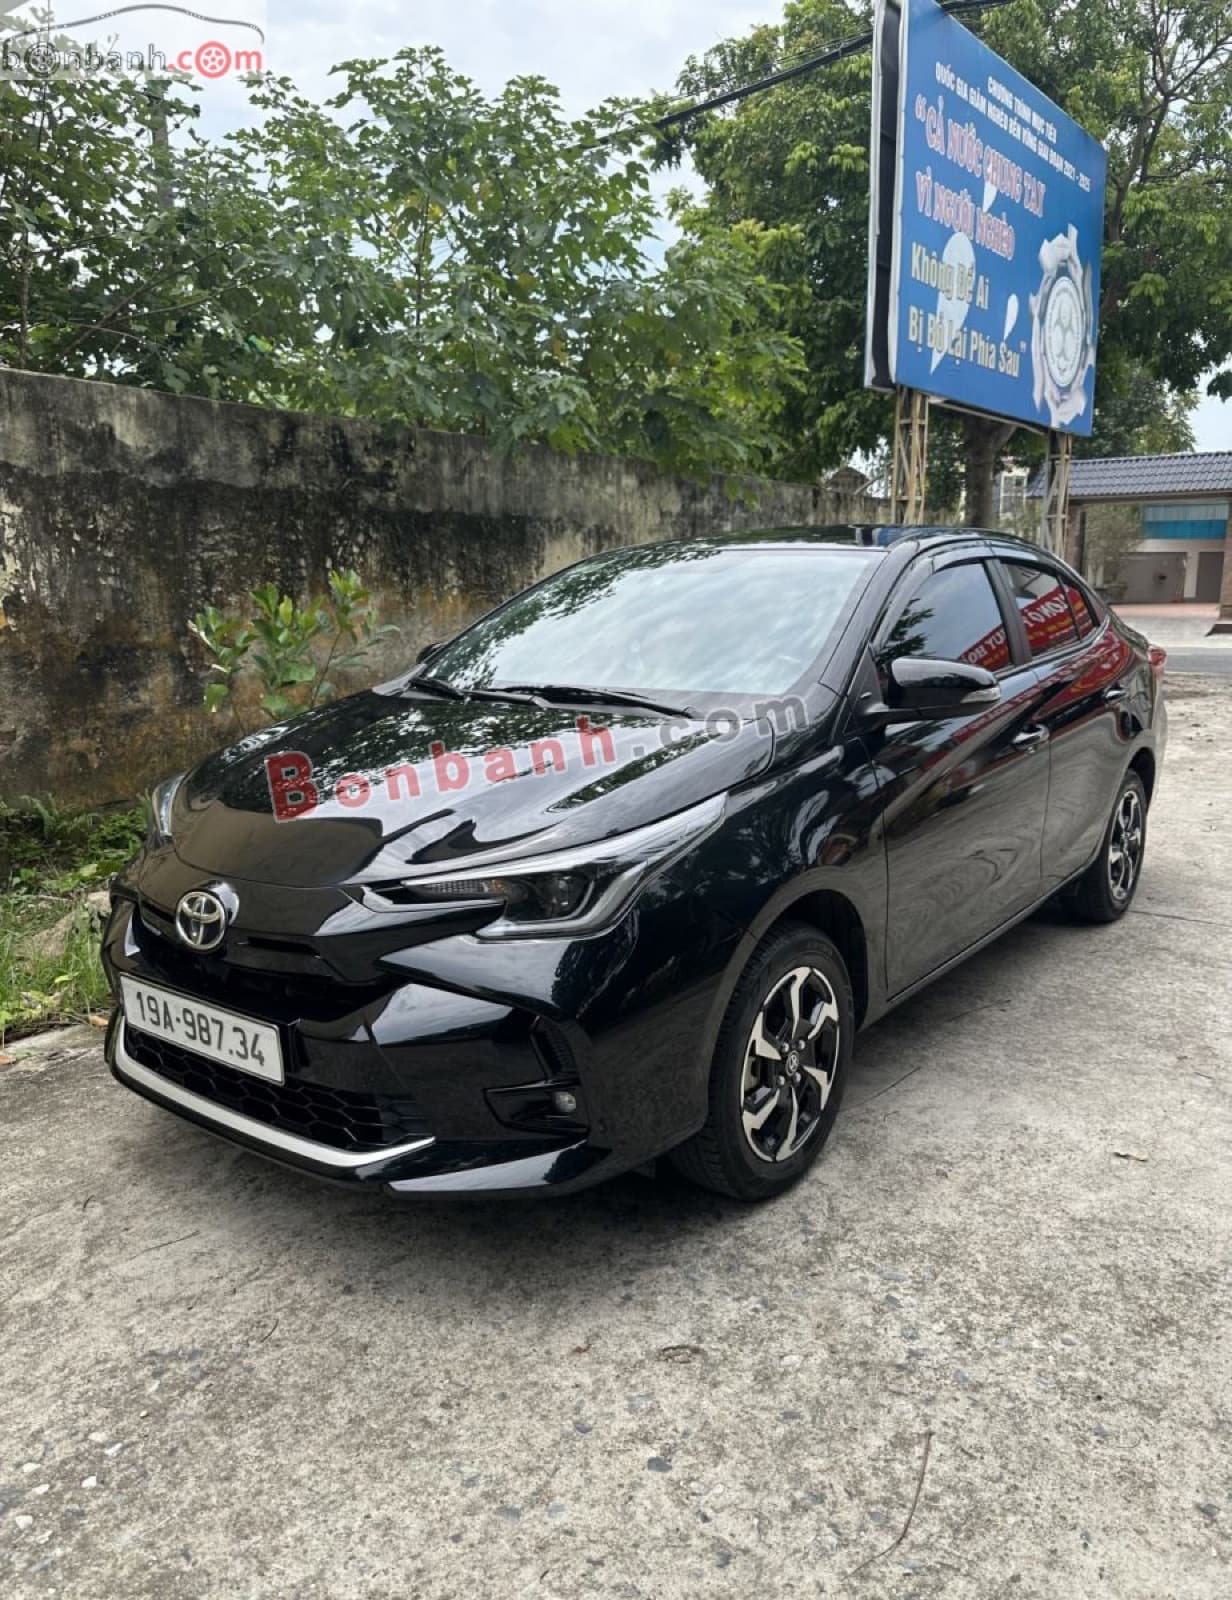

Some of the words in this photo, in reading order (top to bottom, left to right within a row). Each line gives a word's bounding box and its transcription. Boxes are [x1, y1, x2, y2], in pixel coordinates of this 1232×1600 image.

[947, 118, 984, 178] NƯỚC
[983, 145, 1023, 204] CHUNG
[1023, 171, 1046, 218] TAY
[915, 166, 933, 217] VÌ
[933, 182, 975, 241] NGƯỜI
[976, 207, 1016, 261] NGHÈO
[911, 241, 954, 301] Không
[956, 263, 974, 304] Để
[976, 275, 989, 310] Ai
[908, 304, 923, 352] Bị
[945, 320, 967, 365] Lại
[970, 331, 996, 370] Phía
[136, 991, 265, 1067] 19A-987.34
